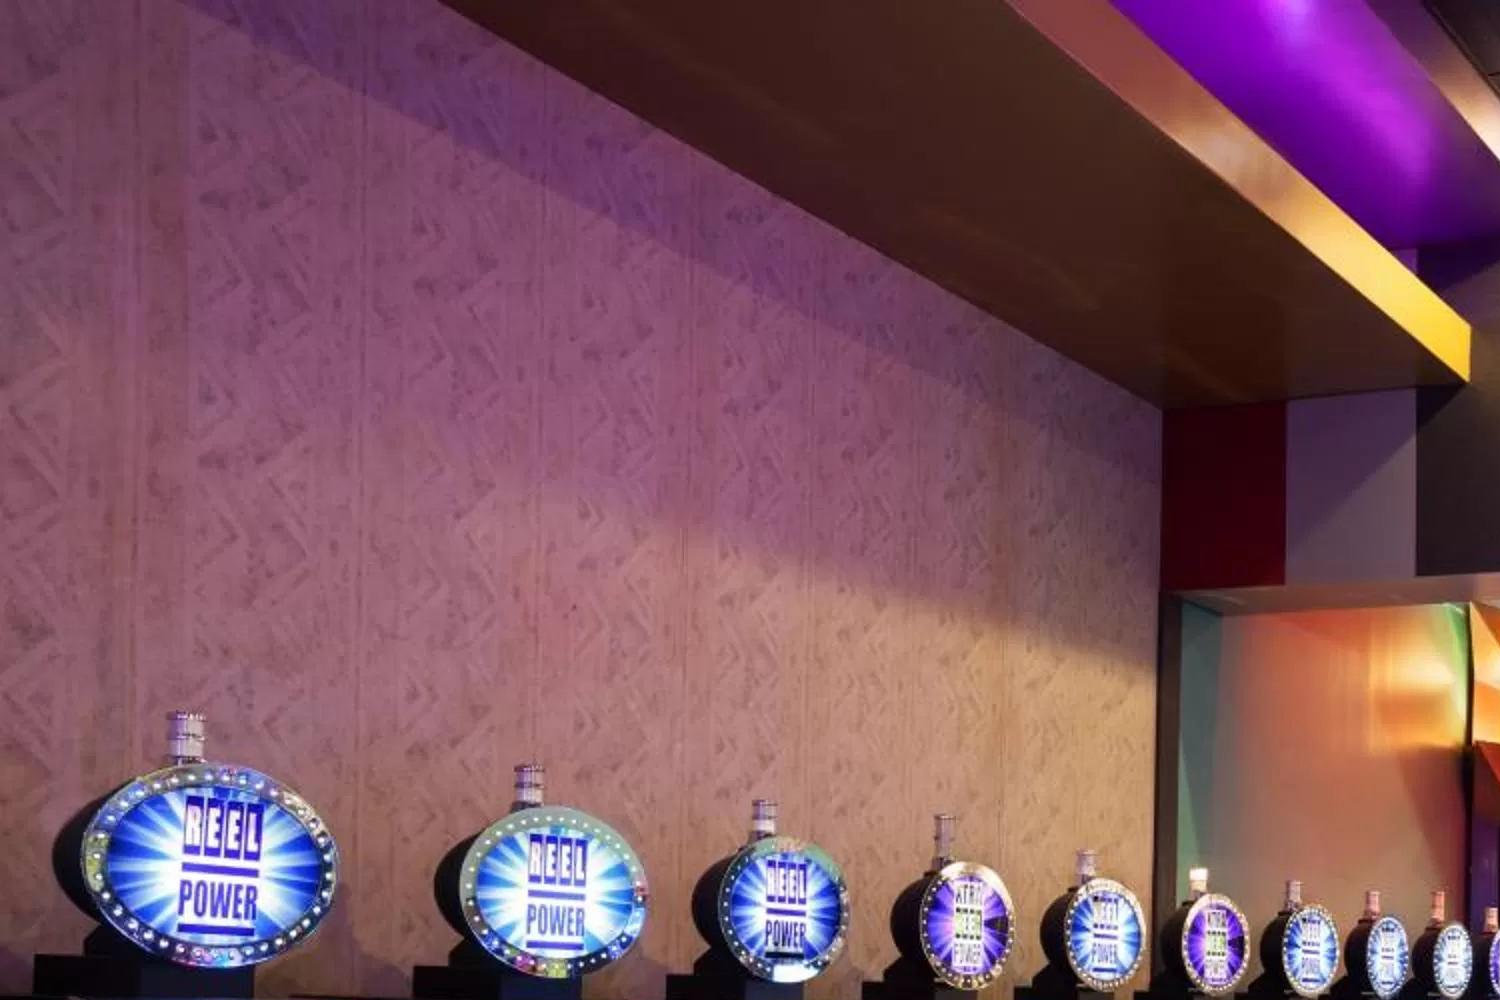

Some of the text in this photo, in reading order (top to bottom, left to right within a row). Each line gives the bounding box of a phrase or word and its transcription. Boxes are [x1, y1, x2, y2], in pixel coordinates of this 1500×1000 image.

[184, 799, 262, 857] REEL
[529, 838, 586, 884] REEL
[177, 879, 258, 921] POWER
[767, 862, 807, 903] REEL
[526, 903, 585, 937] POWER
[765, 919, 807, 951] POWER
